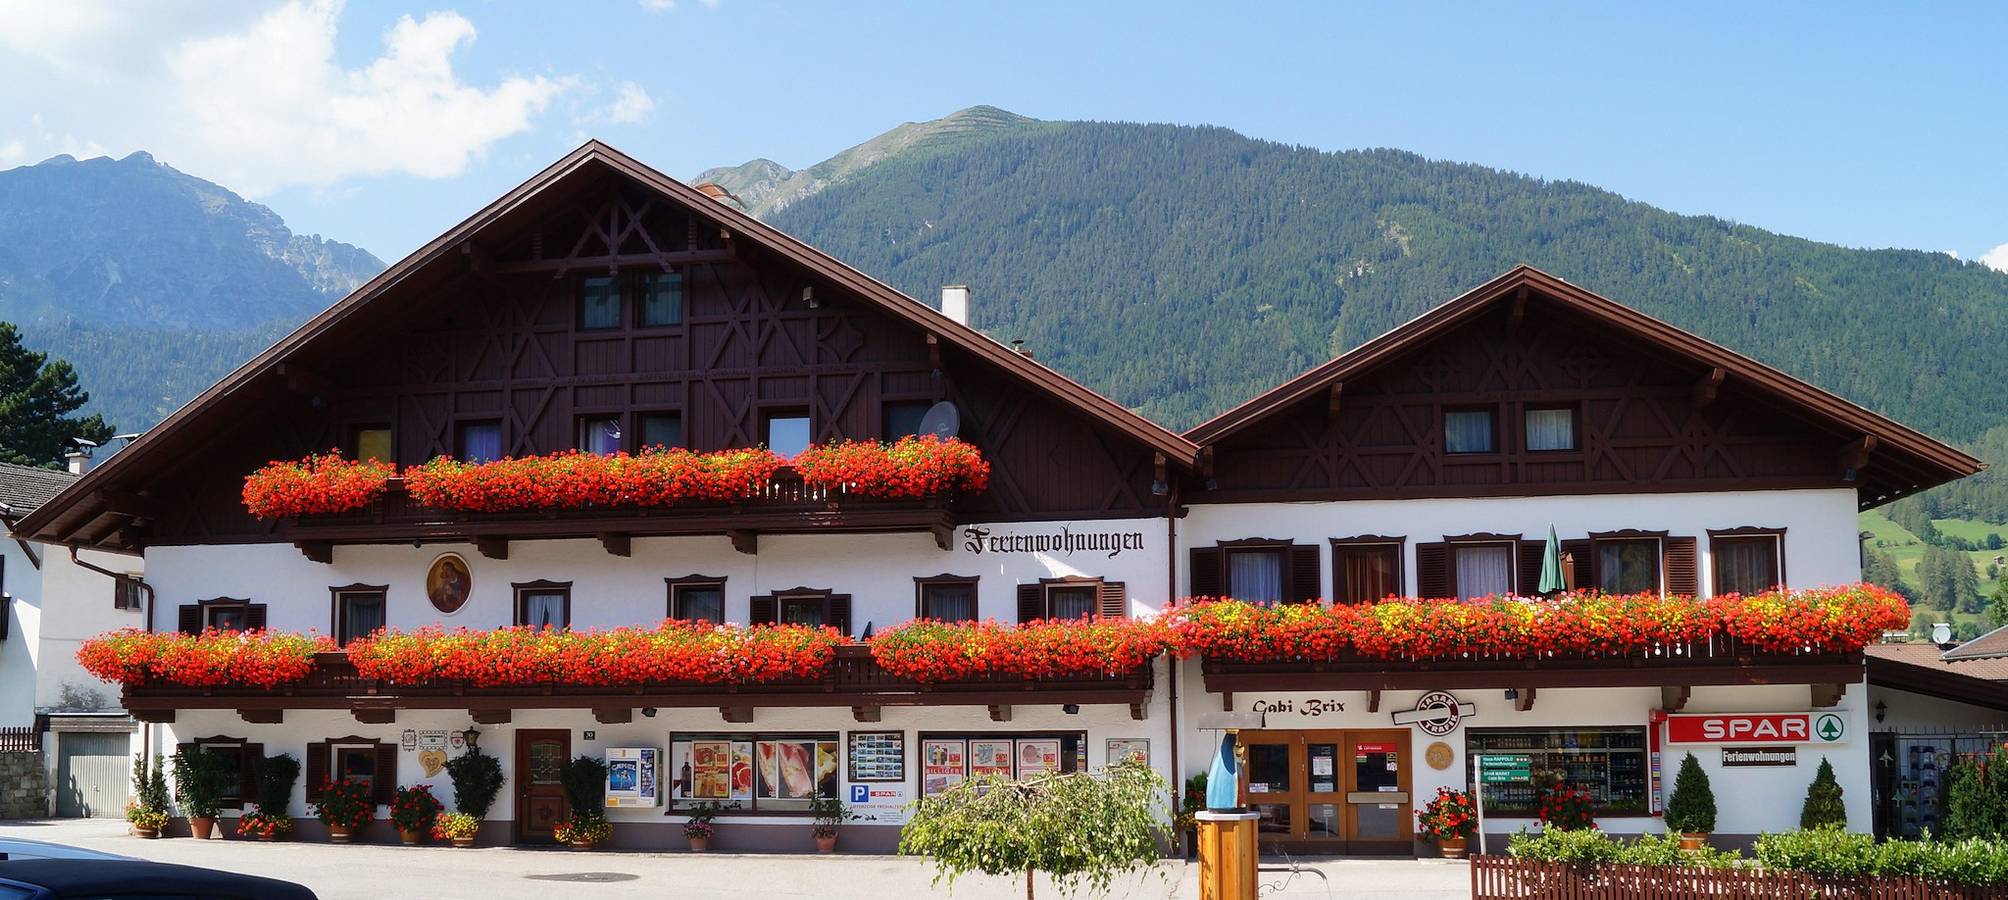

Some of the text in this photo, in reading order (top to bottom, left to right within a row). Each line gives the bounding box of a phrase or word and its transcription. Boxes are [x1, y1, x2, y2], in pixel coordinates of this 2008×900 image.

[963, 522, 1145, 560] Ferienwohnungen
[1252, 699, 1345, 716] Gabi Brix
[1420, 694, 1454, 709] TABAK
[1425, 714, 1458, 733] TRAFIK
[1703, 718, 1806, 739] SPAR
[1722, 750, 1796, 763] Ferienwohnungen
[855, 786, 865, 801] P
